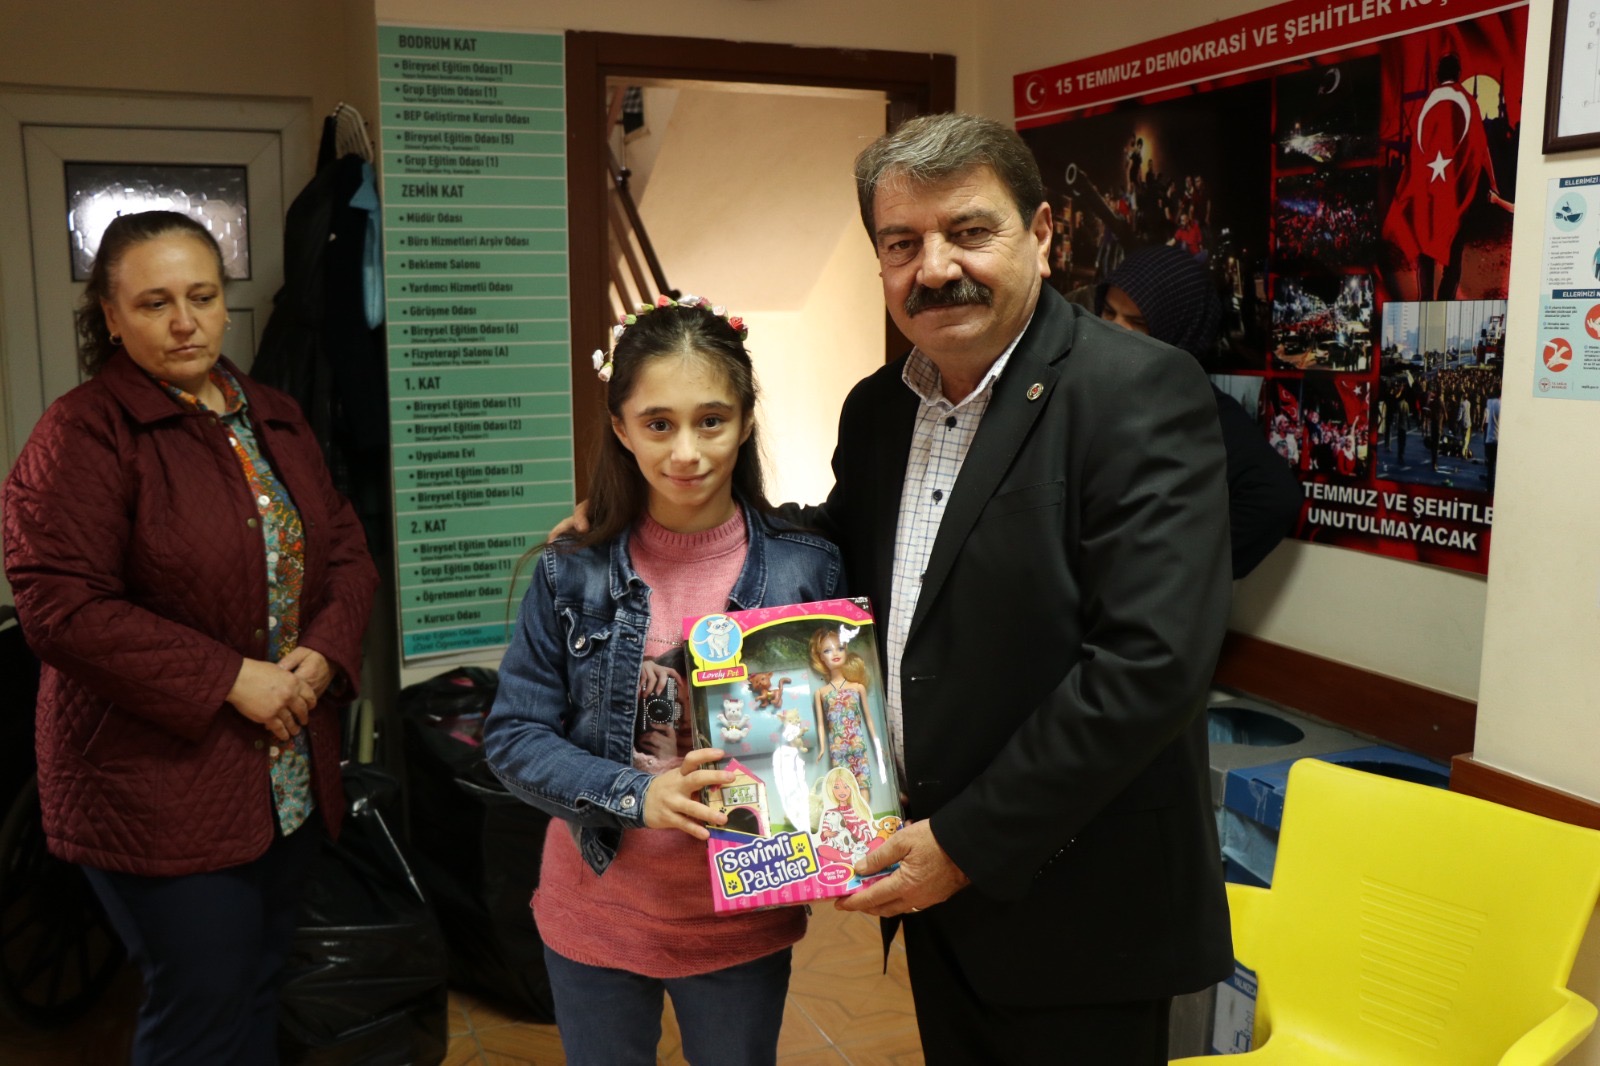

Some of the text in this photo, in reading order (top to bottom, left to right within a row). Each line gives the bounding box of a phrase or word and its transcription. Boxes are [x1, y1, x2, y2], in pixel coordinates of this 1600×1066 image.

[399, 35, 477, 51] BODRUM KAT
[1056, 0, 1392, 95] 15 TEMMUZ DEMOKRASİ VE ŞEHİTLER
[402, 60, 440, 73] Bireysel
[442, 62, 470, 75] Eğitim
[473, 64, 498, 74] Odası
[402, 84, 424, 96] Grup
[427, 85, 455, 97] Eğitim
[458, 86, 482, 97] Odası
[404, 110, 530, 124] BEP Geliştirme Kurulu Odası
[404, 132, 442, 144] Bireysel
[444, 132, 472, 145] Eğitim
[474, 134, 499, 144] Odası
[405, 156, 426, 168] Grup
[429, 156, 457, 168] Eğitim
[460, 157, 484, 167] Odası
[1565, 178, 1598, 186] ELLERİMİZİ
[402, 182, 464, 198] ZEMİN KAT
[408, 212, 462, 223] Müdür Odası
[408, 236, 529, 248] Büro Hizmetleri Arşiv Odası
[409, 260, 480, 270] Bekleme Salonu
[410, 282, 513, 293] Yardımcı Hizmetli Odası
[410, 306, 476, 318] Görüşme Odası
[411, 325, 448, 337] Bireysel
[450, 324, 478, 336] Eğitim
[480, 324, 504, 334] Odası
[412, 348, 460, 360] Fizyoterapi
[463, 347, 493, 358] Salonu
[405, 377, 440, 390] 1. KAT
[414, 400, 450, 412] Bireysel
[453, 399, 480, 411] Eğitim
[482, 398, 507, 408] Odası
[415, 424, 451, 435] Bireysel
[454, 422, 481, 434] Eğitim
[484, 421, 508, 431] Odası
[416, 448, 475, 462] Uygulama Evi
[417, 469, 453, 480] Bireysel
[456, 467, 482, 479] Eğitim
[485, 466, 508, 476] Odası
[418, 492, 454, 503] Bireysel
[456, 490, 484, 502] Eğitim
[486, 488, 510, 498] Odası
[1303, 482, 1378, 507] TEMMUZ
[1383, 492, 1408, 512] VE
[412, 520, 447, 534] 2. KAT
[1308, 508, 1476, 550] UNUTULMAYACAK
[420, 542, 456, 554] Bireysel
[458, 540, 485, 552] Eğitim
[488, 538, 511, 548] Odası
[422, 564, 442, 576] Grup
[444, 562, 471, 575] Eğitim
[474, 561, 497, 571] Odası
[423, 587, 502, 602] Öğretmenler Odası
[424, 612, 480, 624] Kurucu Odası
[702, 669, 740, 680] Lovely Pet
[722, 834, 792, 872] Sevimli
[739, 857, 808, 892] Patiler
